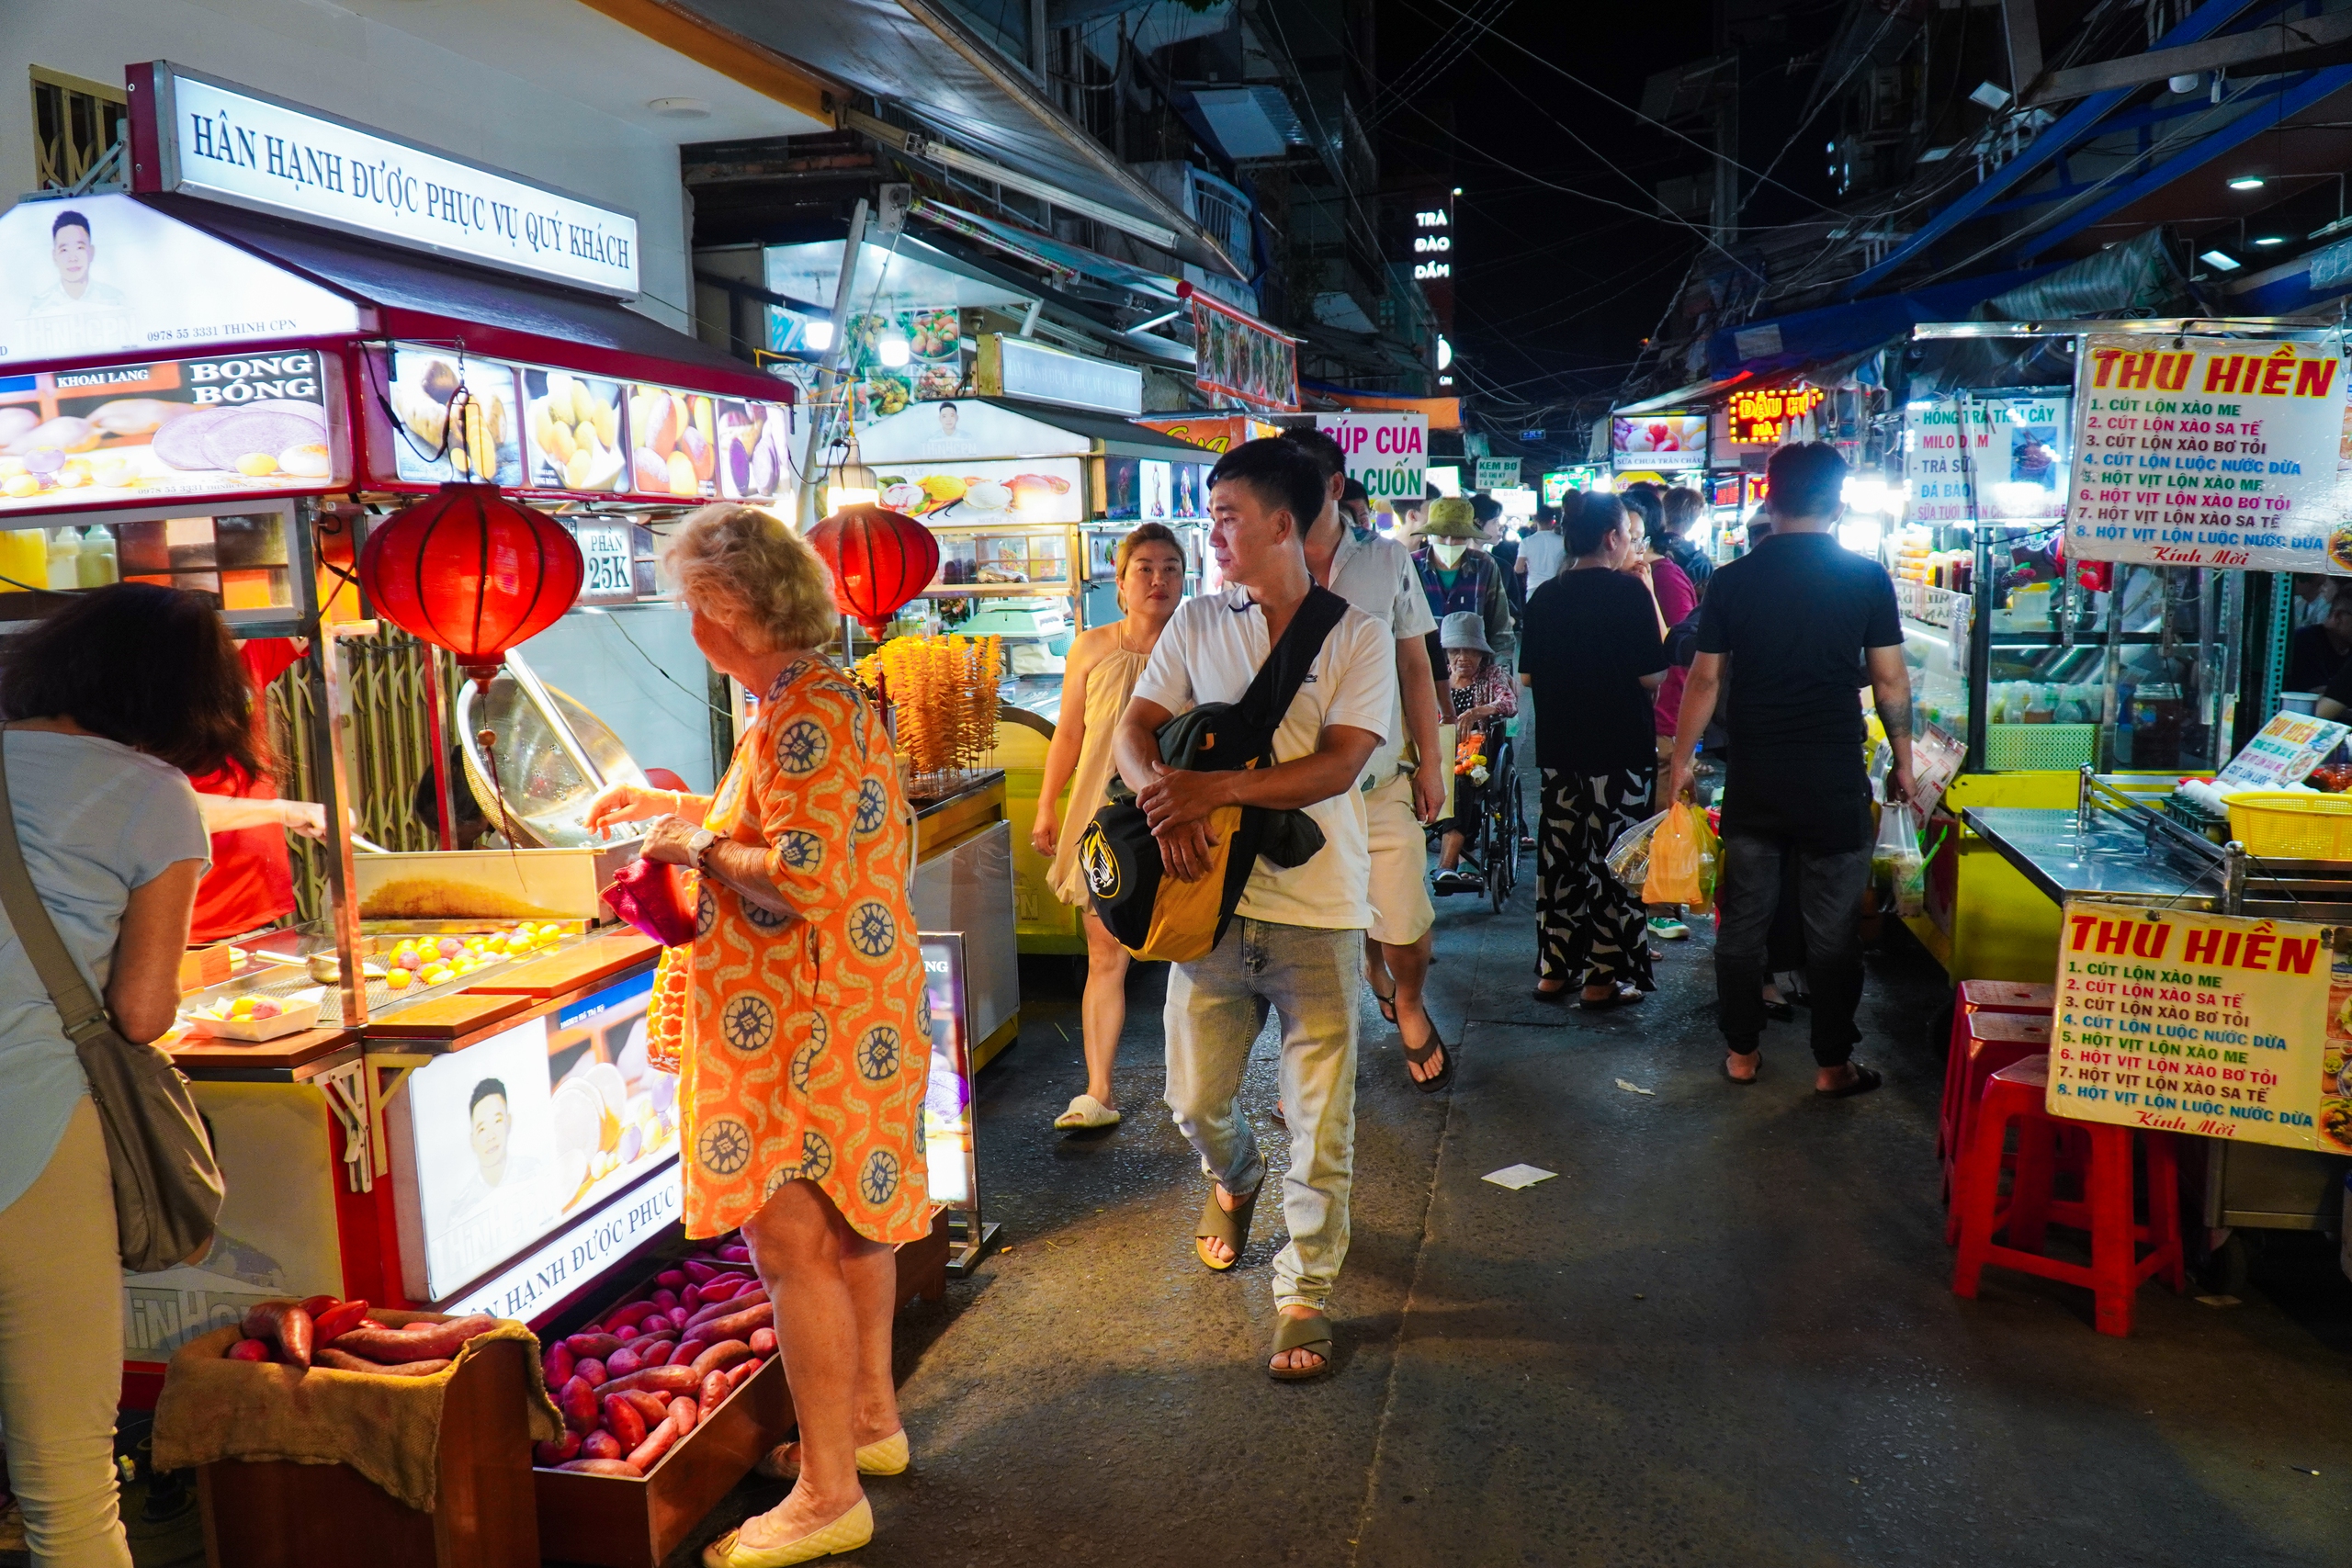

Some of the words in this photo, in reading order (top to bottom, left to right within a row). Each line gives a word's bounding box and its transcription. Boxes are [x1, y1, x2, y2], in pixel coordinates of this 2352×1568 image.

[191, 108, 256, 170] HÂN
[264, 134, 345, 193] HẠNH
[350, 159, 418, 217] ĐƯỢC
[424, 181, 486, 235] PHỤC
[491, 201, 518, 247] VỤ
[526, 209, 562, 253] QUÝ
[568, 221, 629, 269] KHÁCH
[1415, 209, 1448, 227] TRÀ
[1414, 235, 1451, 253] ĐÀO
[147, 329, 172, 342] 0978
[176, 328, 188, 339] 55
[193, 326, 218, 338] 3331
[269, 318, 298, 332] CPN
[57, 374, 104, 389] KHOAI
[107, 368, 149, 383] LANG
[190, 354, 314, 382] BONG
[2093, 347, 2196, 392] THU
[2202, 343, 2338, 398] HIỀN
[191, 377, 317, 404] BÓNG
[1738, 392, 1782, 422] ĐẬU
[1923, 406, 1959, 424] HỒNG
[2029, 404, 2055, 423] CÂY
[2109, 397, 2140, 412] CÚT
[2145, 398, 2177, 414] LỘN
[2181, 400, 2212, 415] XÀO
[2218, 404, 2241, 416] ME
[2108, 415, 2138, 430] CÚT
[2143, 416, 2174, 434] LỘN
[2179, 418, 2211, 434] XÀO
[2215, 423, 2234, 434] SA
[2240, 419, 2264, 435] TẾ
[1375, 426, 1422, 455] CUA
[1923, 434, 1955, 448] MILO
[1960, 434, 1989, 448] DM
[2106, 433, 2136, 447] CÚT
[2142, 434, 2172, 452] LỘN
[2177, 436, 2209, 452] XÀO
[2213, 439, 2236, 453] BƠ
[2240, 438, 2267, 455] TỎI
[1479, 461, 1500, 470] KEM
[1680, 456, 1703, 464] CHÂU
[1922, 456, 1947, 473] TRÀ
[2103, 452, 2134, 466] CÚT
[2139, 453, 2170, 470] LỘN
[2176, 455, 2216, 471] LUỘC
[2222, 457, 2265, 473] NƯỚC
[2268, 459, 2301, 475] DỪA
[1363, 457, 1421, 496] CUỐN
[1921, 480, 1939, 498] ĐÁ
[1944, 480, 1971, 497] BÀO
[1917, 502, 1936, 520] SỮA
[2099, 488, 2132, 504] HỘT
[2136, 491, 2160, 506] VỊT
[2165, 491, 2197, 508] LỘN
[2201, 492, 2233, 508] XÀO
[2238, 496, 2261, 509] BƠ
[2265, 494, 2290, 511] TỎI
[591, 525, 622, 551] PHẦN
[2096, 524, 2127, 540] HỘT
[2132, 527, 2156, 543] VỊT
[2162, 526, 2193, 544] LỘN
[2198, 530, 2239, 546] LUỘC
[2244, 533, 2286, 547] NƯỚC
[2291, 535, 2324, 550] DỪA
[2147, 546, 2202, 563] Kính
[2206, 549, 2250, 565] Mời
[589, 556, 629, 589] 25K
[2071, 915, 2171, 959] THU
[2184, 921, 2319, 975] HIỀN
[2086, 962, 2118, 976] CÚT
[2123, 965, 2155, 982] LỘN
[2161, 969, 2193, 985] XÀO
[2198, 975, 2222, 987] ME
[2086, 979, 2116, 994] CÚT
[2122, 983, 2154, 998] LỘN
[2159, 987, 2191, 1002] XÀO
[2196, 993, 2216, 1005] SA
[2222, 993, 2245, 1009] TẾ
[2084, 997, 2115, 1011] CÚT
[2120, 1001, 2152, 1017] LỘN
[2157, 1005, 2189, 1021] XÀO
[2195, 1010, 2219, 1023] BƠ
[2222, 1010, 2249, 1027] TỎI
[2083, 1014, 2113, 1029] CÚT
[2119, 1019, 2151, 1034] LỘN
[2156, 1023, 2199, 1040] LUỘC
[2204, 1029, 2247, 1045] NƯỚC
[2253, 1033, 2287, 1050] DỪA
[2082, 1032, 2113, 1047] HỘT
[2119, 1037, 2143, 1053] VỊT
[2149, 1040, 2180, 1055] LỘN
[2186, 1043, 2218, 1060] XÀO
[2223, 1050, 2248, 1064] ME
[2080, 1049, 2111, 1065] HỘT
[2117, 1055, 2142, 1070] VỊT
[2147, 1057, 2179, 1074] LỘN
[2185, 1062, 2217, 1077] XÀO
[2222, 1068, 2246, 1081] BƠ
[2250, 1068, 2277, 1086] TỎI
[2077, 1085, 2109, 1100] HỘT
[2114, 1090, 2139, 1106] VỊT
[2144, 1093, 2177, 1110] LỘN
[2182, 1100, 2224, 1116] LUỘC
[2230, 1105, 2274, 1122] NƯỚC
[2278, 1111, 2312, 1127] DỪA
[2130, 1110, 2187, 1131] Kính
[2191, 1119, 2235, 1136] Mời
[505, 1257, 566, 1317] HẠNH
[571, 1223, 623, 1273] ĐƯỢC
[628, 1185, 675, 1234] PHỤC
